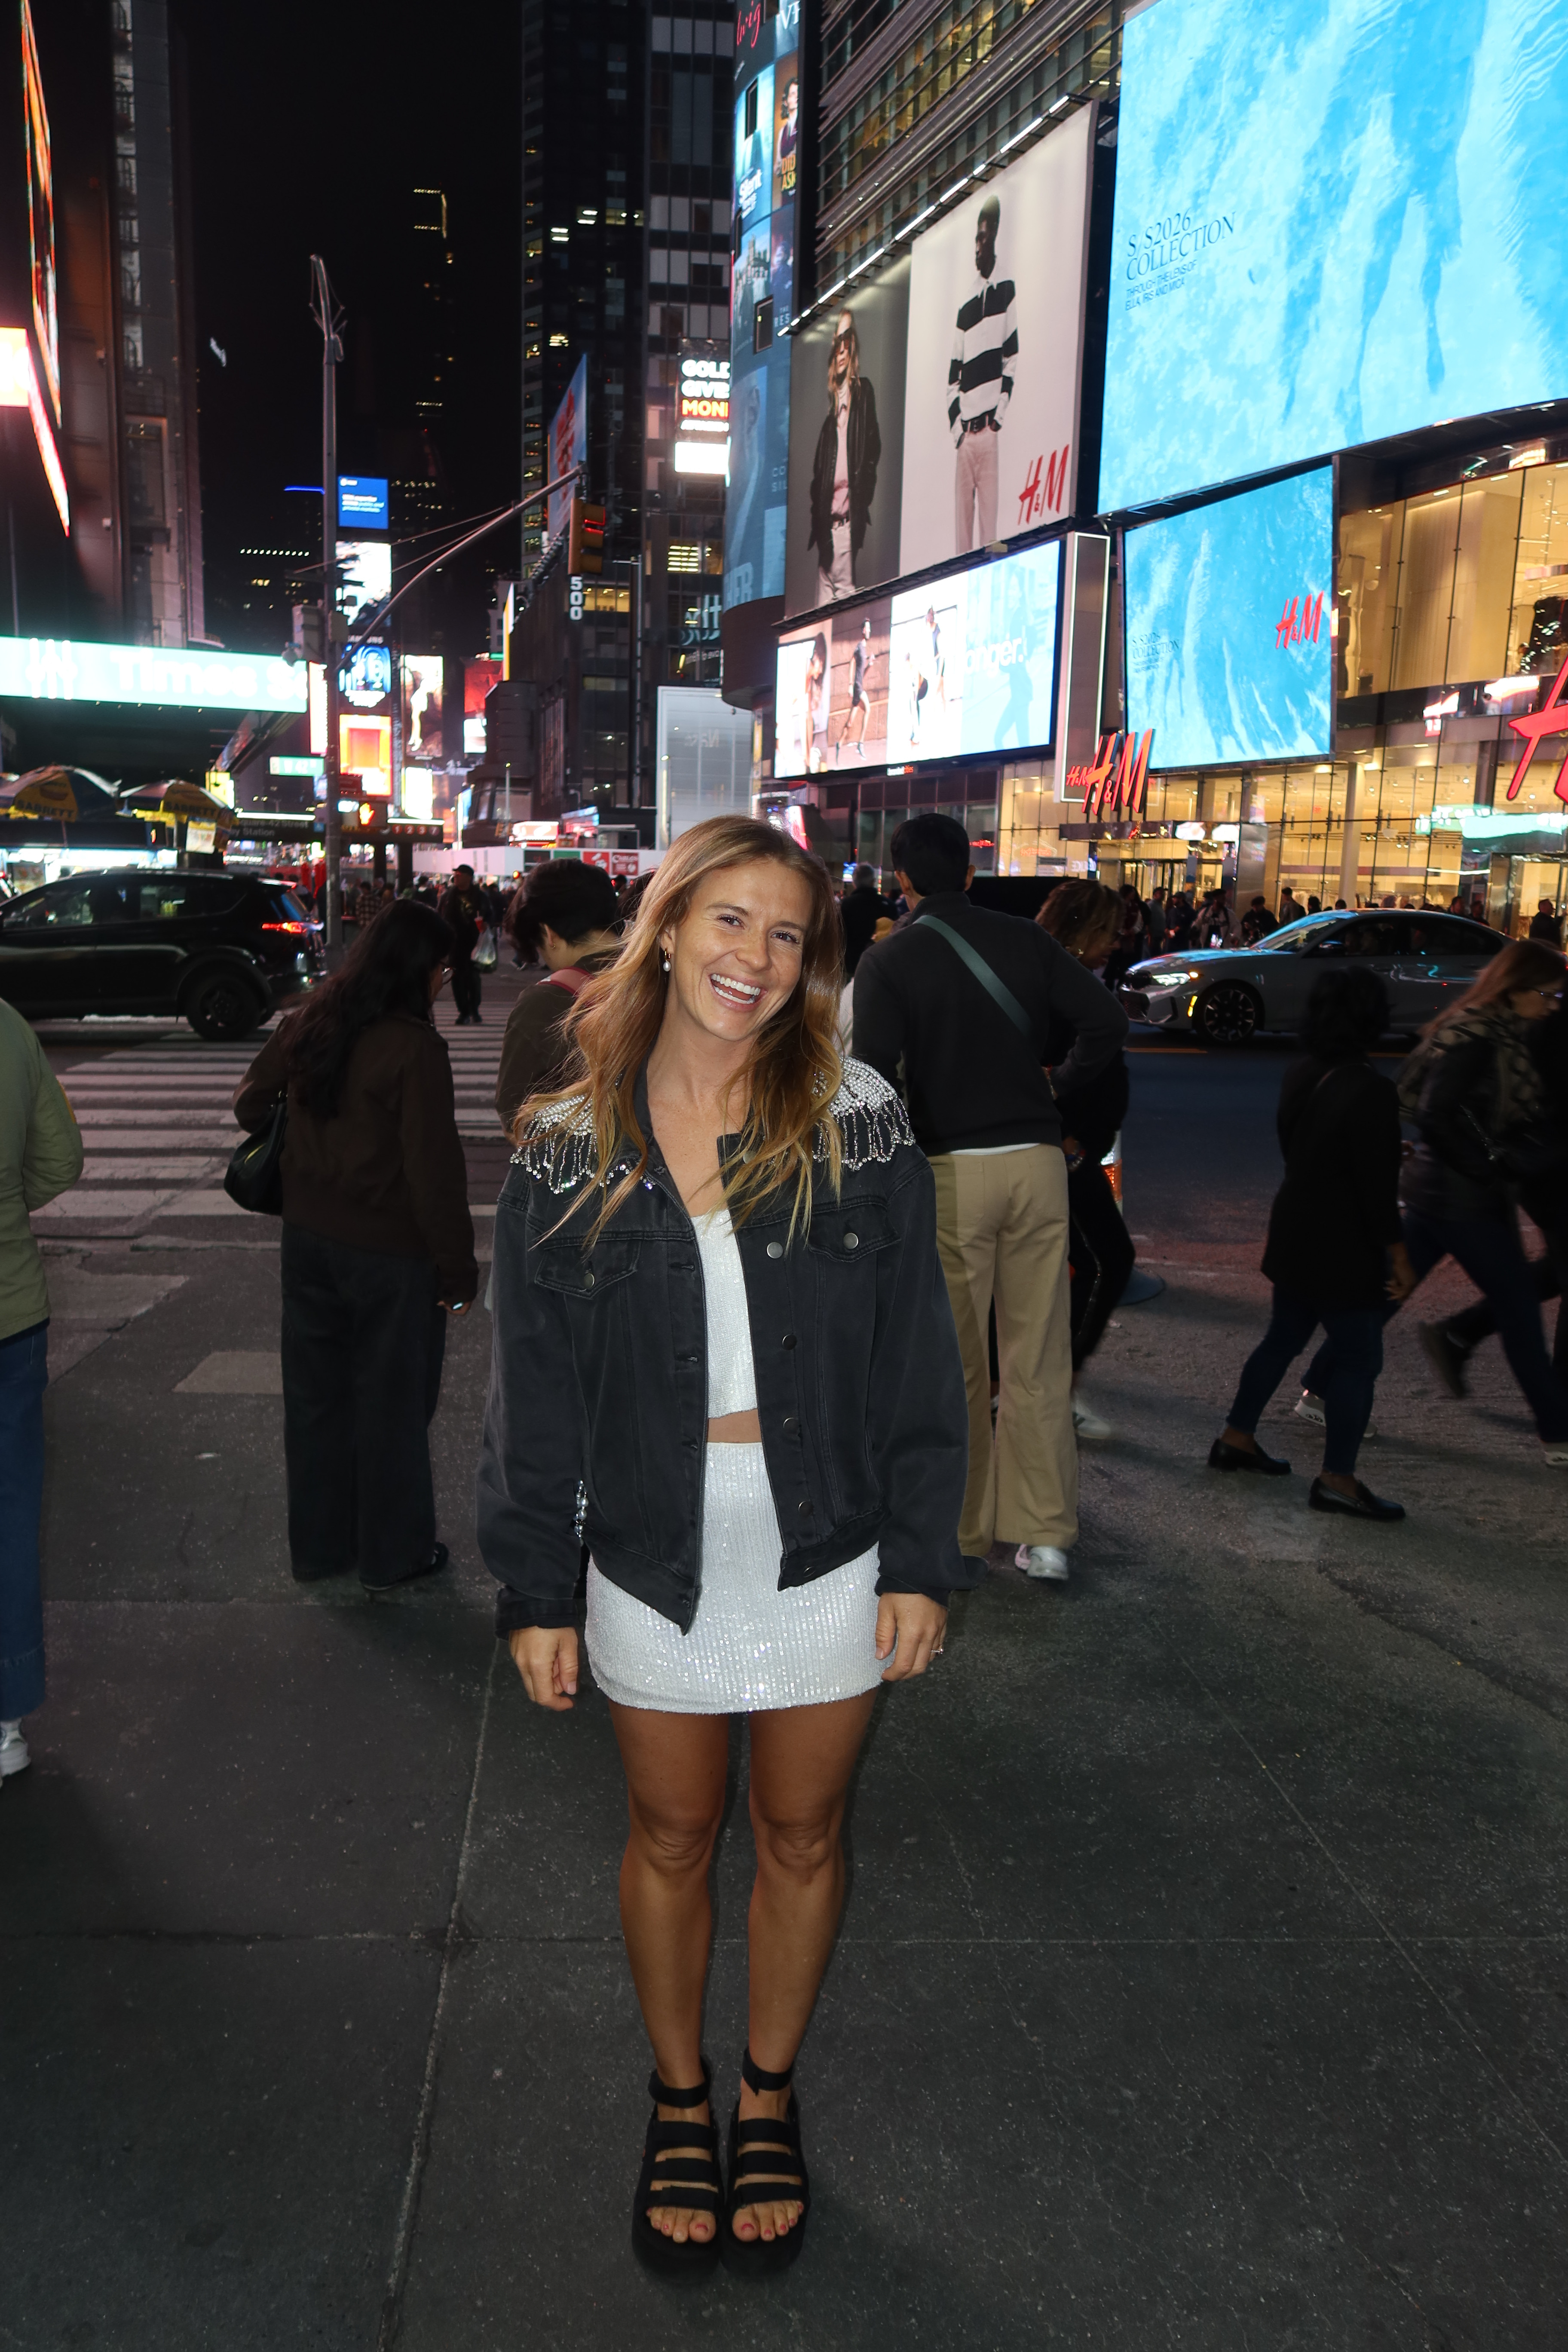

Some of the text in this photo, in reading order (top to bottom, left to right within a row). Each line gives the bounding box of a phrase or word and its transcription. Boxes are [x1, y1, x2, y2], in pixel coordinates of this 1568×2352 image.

[1127, 208, 1191, 258] S/S2026
[1127, 211, 1236, 280] COLLECTION
[1127, 259, 1197, 298] THROUGH THE LENS OF
[1155, 284, 1168, 298] AND
[1169, 277, 1185, 293] MICA
[682, 399, 729, 417] MON
[1018, 444, 1069, 526] H&M
[570, 576, 583, 620] 500
[1276, 590, 1324, 649] H&M
[110, 647, 257, 698] Times
[1082, 728, 1153, 815] H&M
